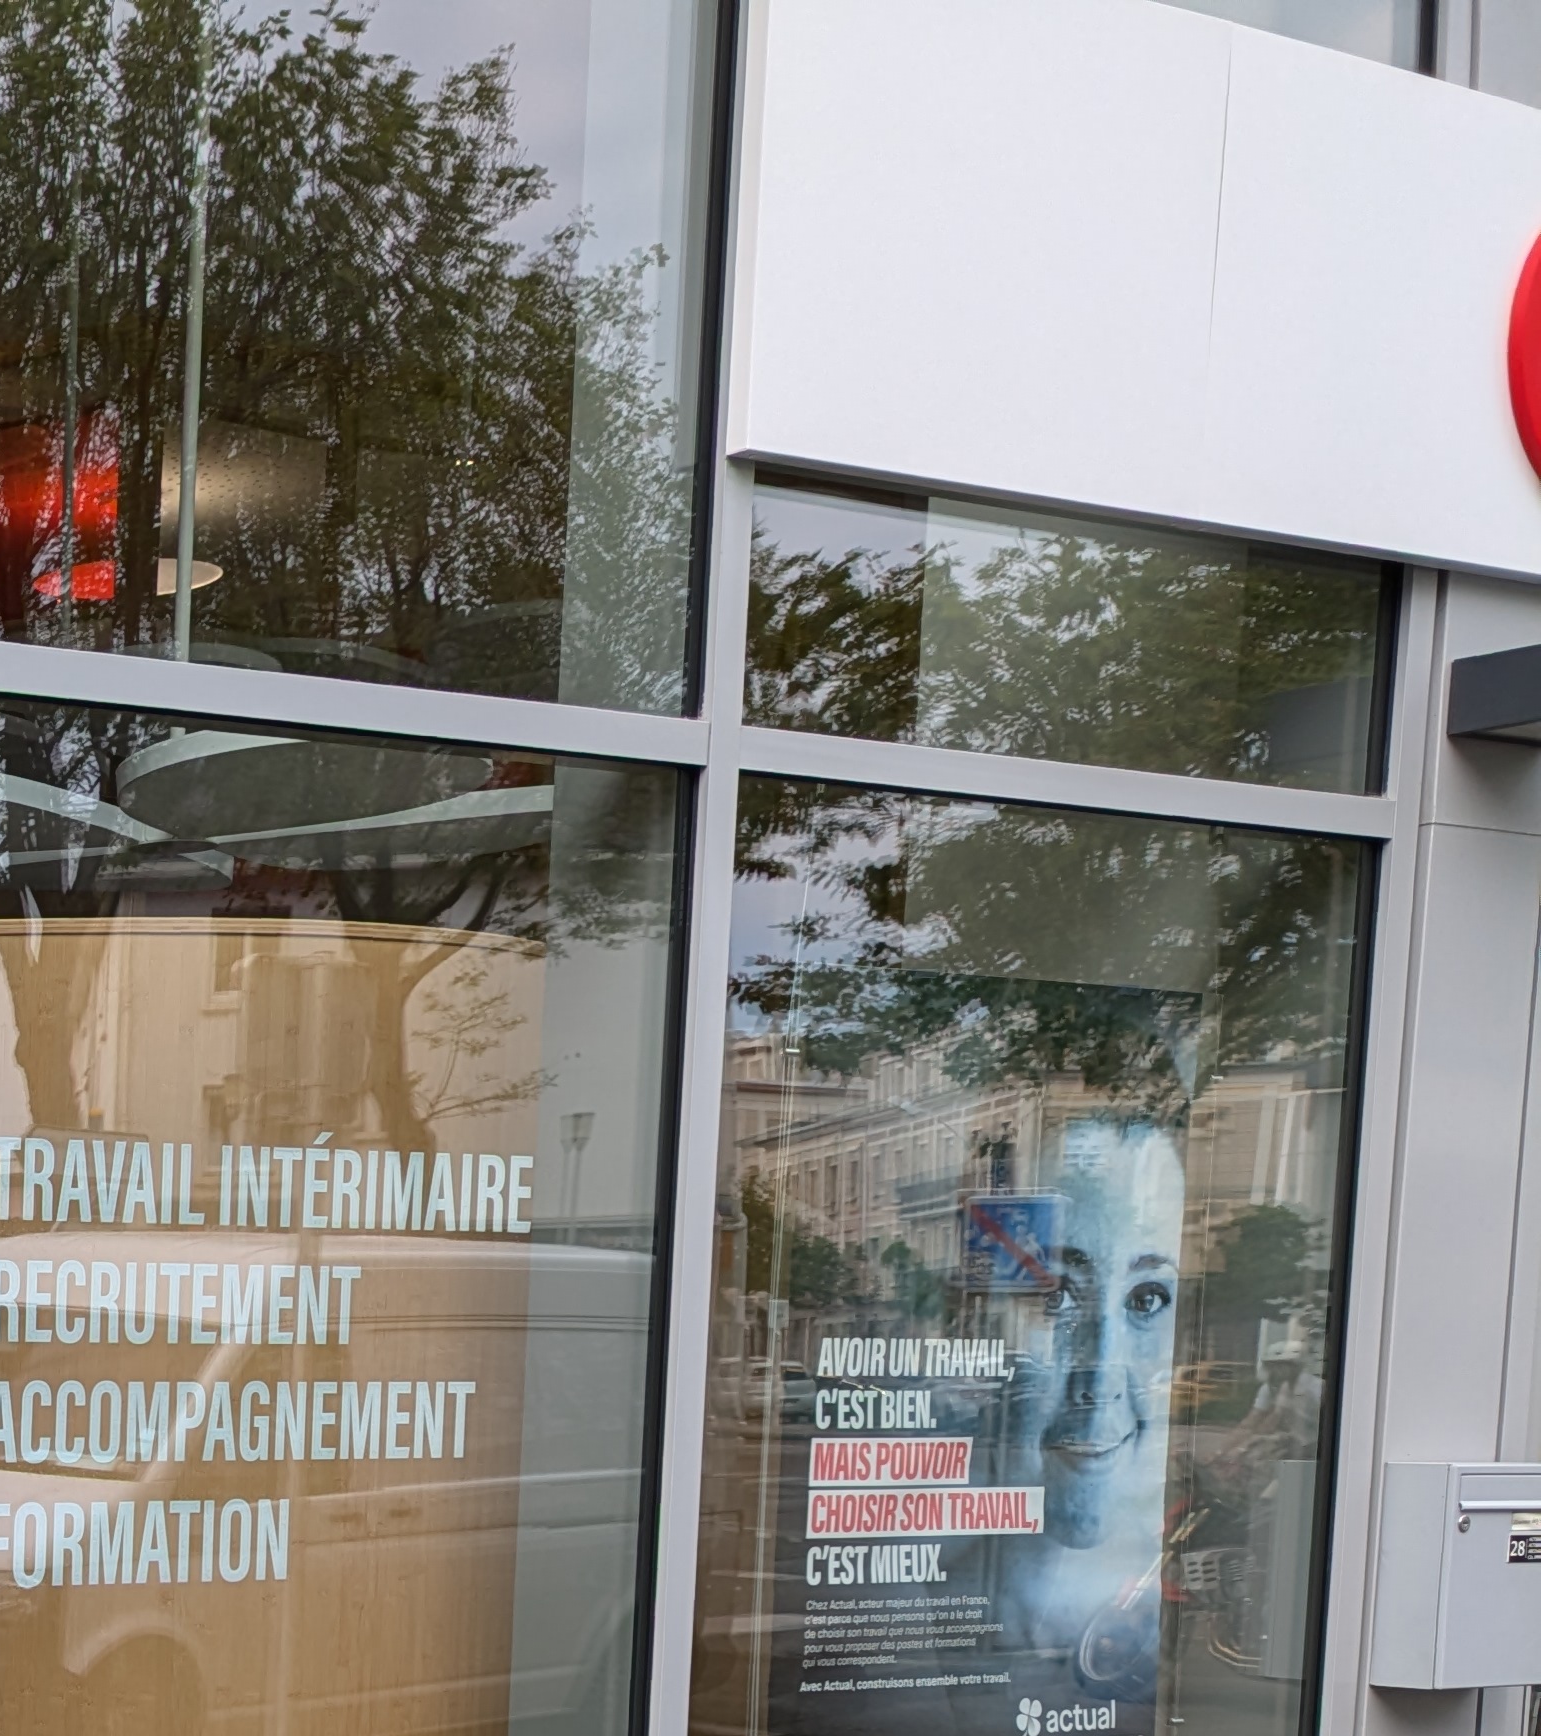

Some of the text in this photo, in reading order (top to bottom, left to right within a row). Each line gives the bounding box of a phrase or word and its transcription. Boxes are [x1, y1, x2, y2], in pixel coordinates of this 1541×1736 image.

[221, 1132, 534, 1233] INTÉRIMAIRE
[817, 1337, 1015, 1382] AVOIR UN TRAVAIL,
[816, 1388, 936, 1429] C'EST BIEN.
[813, 1441, 969, 1481] MAIS POUVOIR
[811, 1492, 1039, 1533] CHOISIR SON TRAVAIL,
[806, 1544, 947, 1586] C'EST MIEUX.
[1510, 1540, 1526, 1557] 28
[799, 1681, 822, 1692] Avec
[857, 1678, 914, 1690] construisons
[916, 1676, 957, 1686] ensemble
[959, 1675, 981, 1684] votre
[1046, 1700, 1116, 1734] actual
